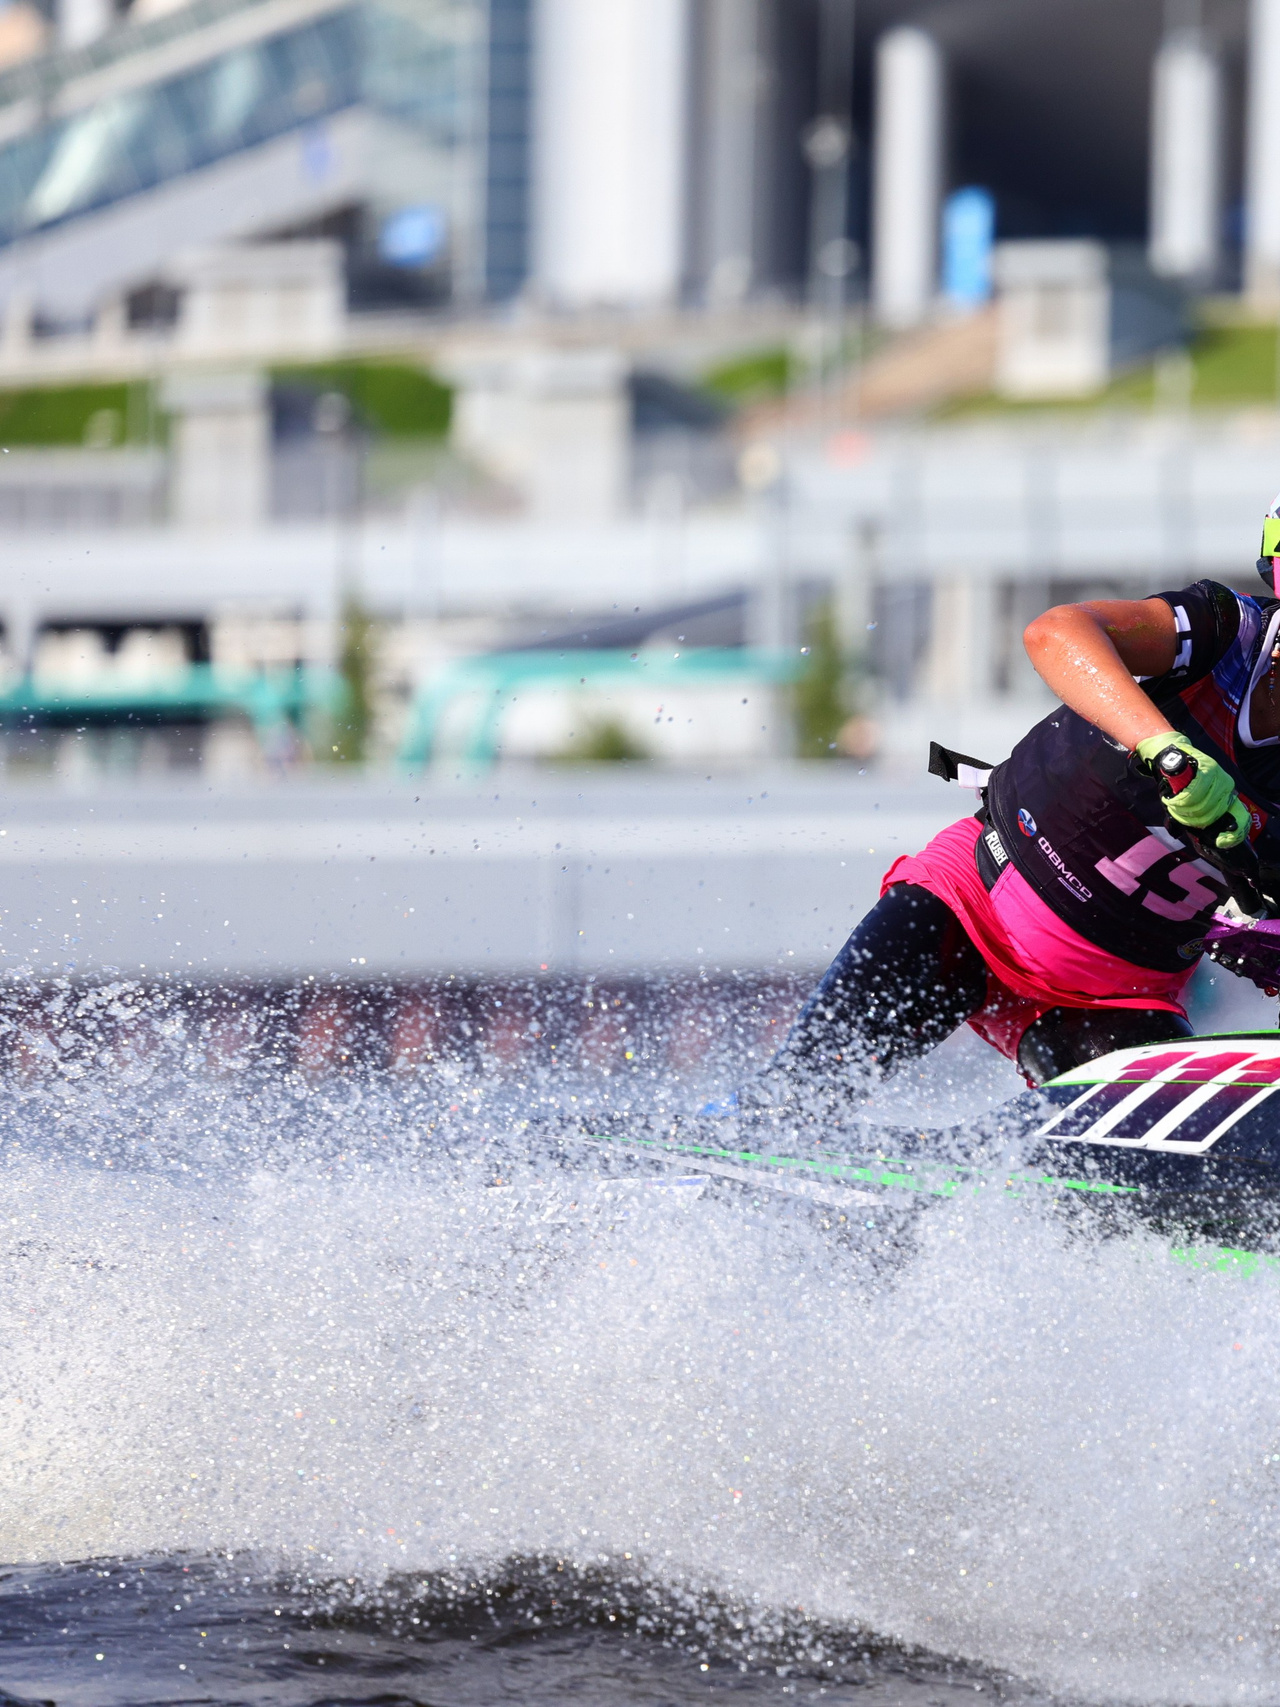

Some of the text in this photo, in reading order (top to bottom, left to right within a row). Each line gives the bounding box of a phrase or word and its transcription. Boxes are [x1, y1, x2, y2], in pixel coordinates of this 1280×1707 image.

[985, 831, 1009, 866] RUSH
[1038, 836, 1093, 898] ФВМСР
[1094, 826, 1228, 921] 15
